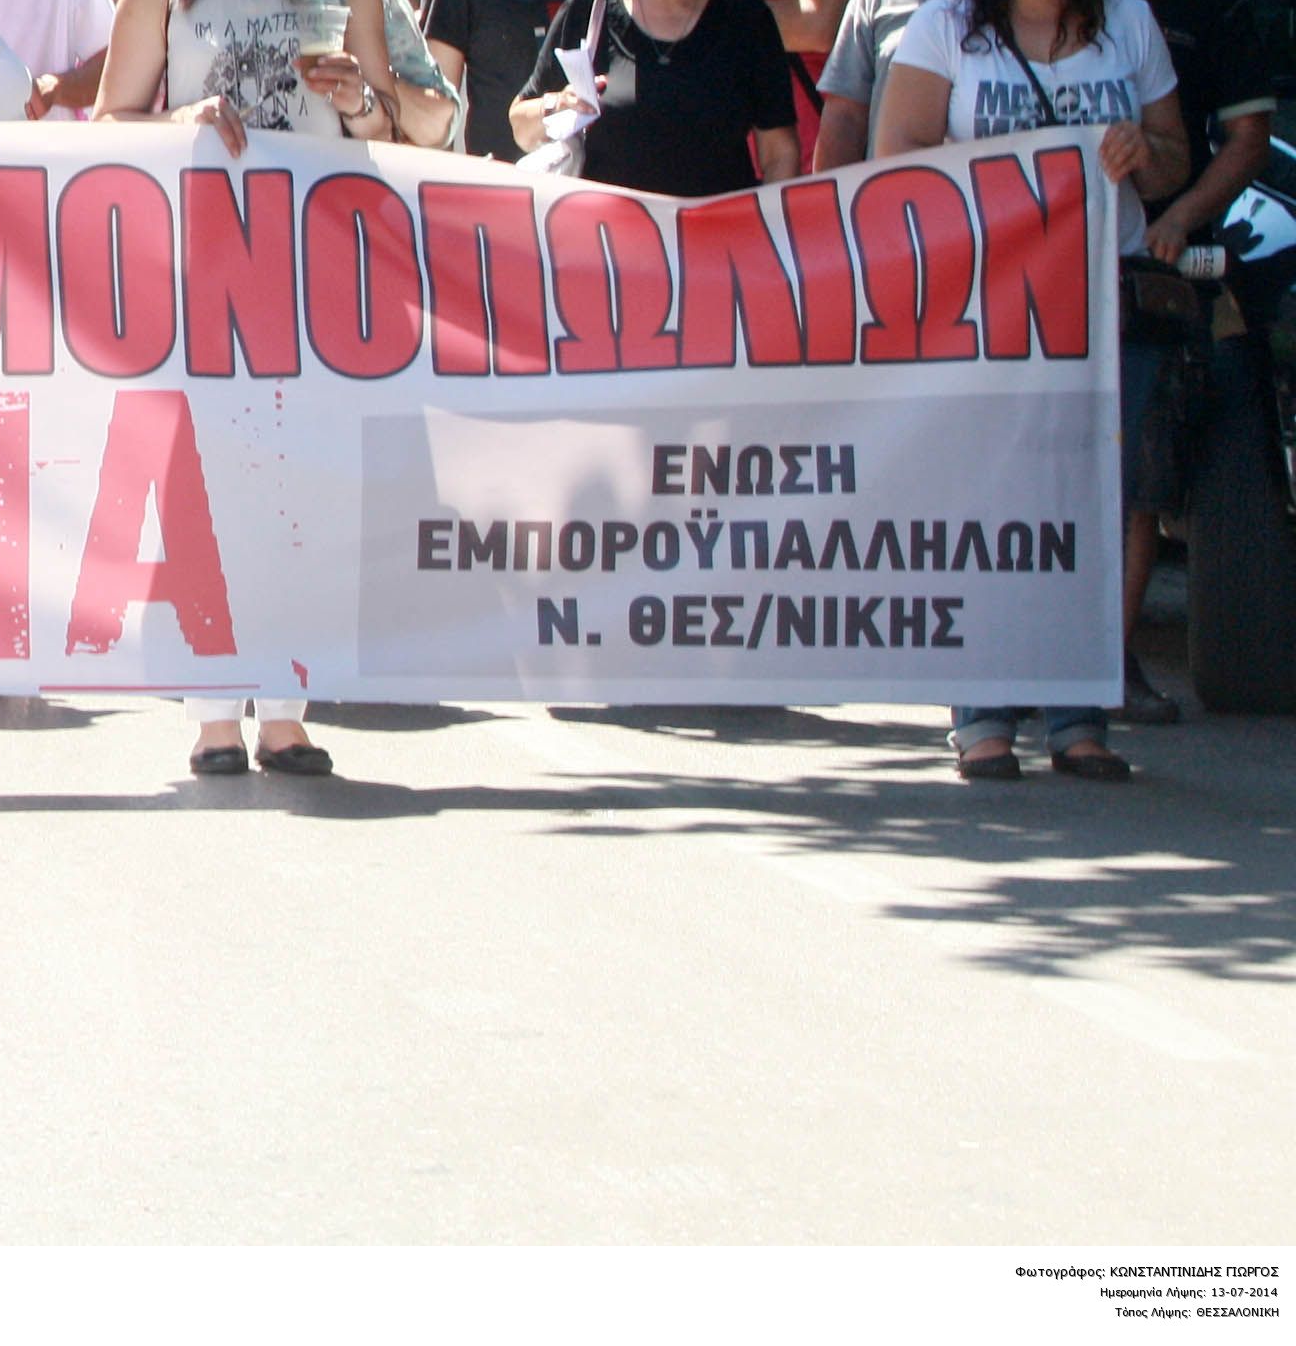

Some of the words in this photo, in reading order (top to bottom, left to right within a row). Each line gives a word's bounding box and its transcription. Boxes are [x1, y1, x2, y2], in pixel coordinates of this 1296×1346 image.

[651, 445, 856, 496] ΕΝΩΣΗ
[417, 509, 1077, 573] ΕΜΠΟΡΟΫΠΑΛΛΗΛΩΝ
[536, 596, 602, 647] Ν.
[628, 594, 965, 651] ΘΕΣ/ΝΙΚΗΣ
